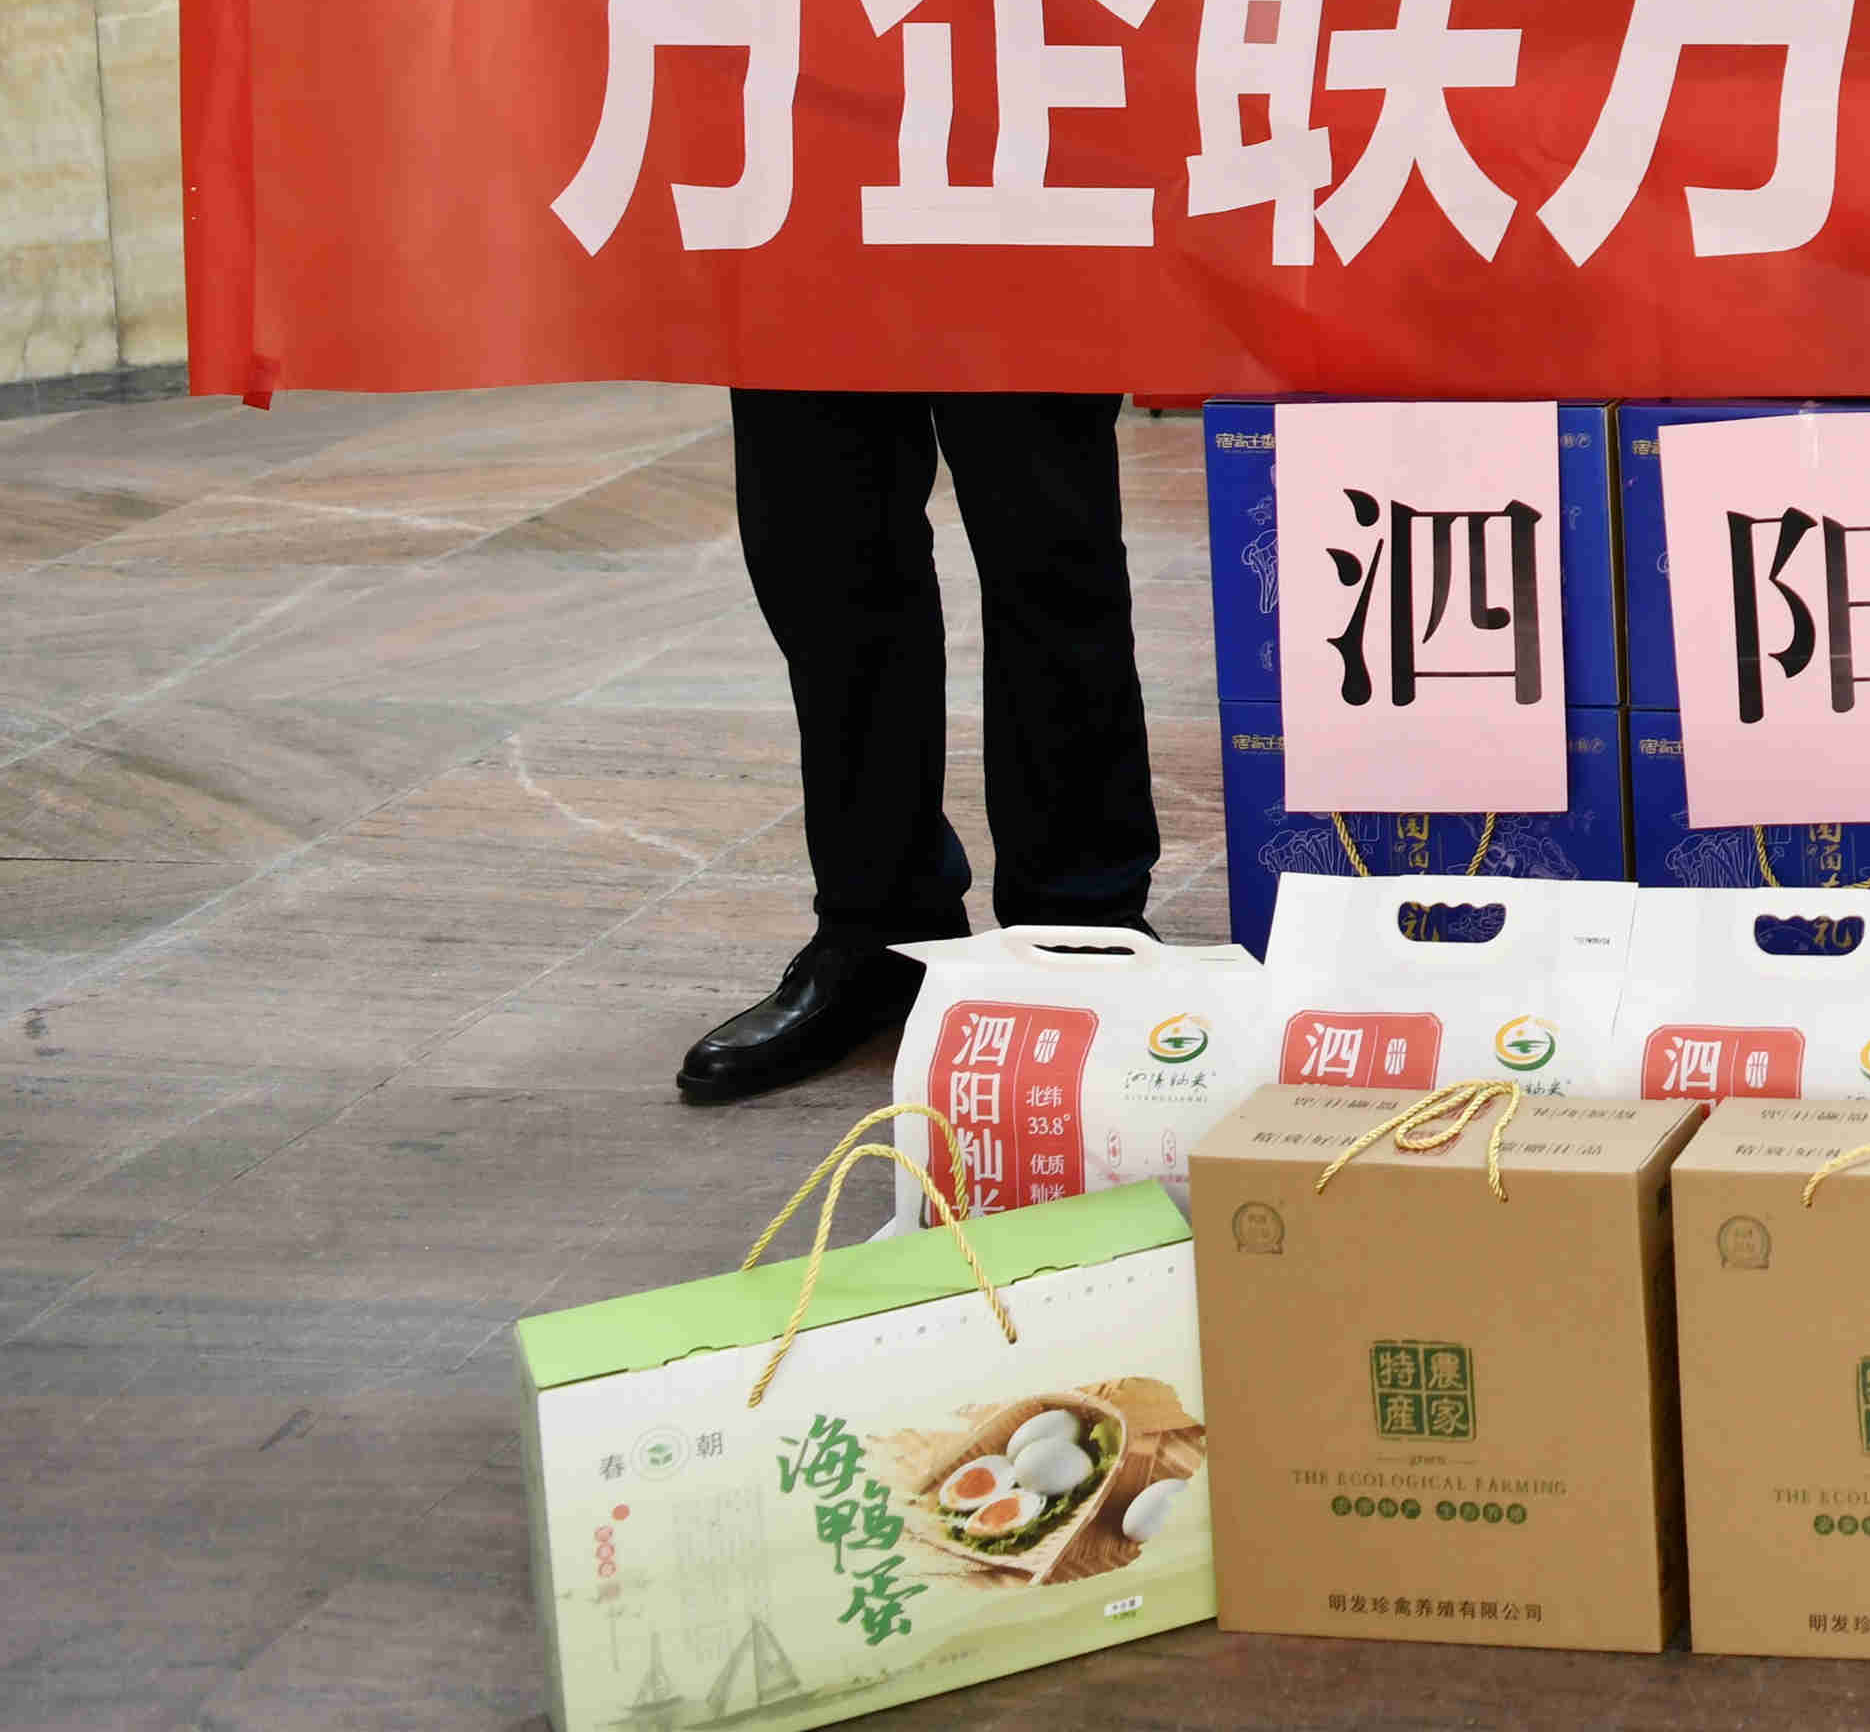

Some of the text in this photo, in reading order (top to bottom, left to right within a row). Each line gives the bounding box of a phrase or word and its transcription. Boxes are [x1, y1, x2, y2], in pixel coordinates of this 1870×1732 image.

[1026, 1085, 1063, 1108] 北纬
[949, 1012, 1017, 1216] 泗阳籼米
[1027, 1113, 1072, 1136] 33.8°
[1030, 1153, 1065, 1175] 优质
[1029, 1183, 1065, 1205] 籼米
[600, 1431, 724, 1481] 春 朝
[1291, 1469, 1568, 1496] THE ECOLOGICAL FARMING
[1772, 1488, 1812, 1505] THE
[777, 1414, 929, 1646] 海鸭蛋
[1327, 1592, 1544, 1623] 明发珍禽养殖有限公司
